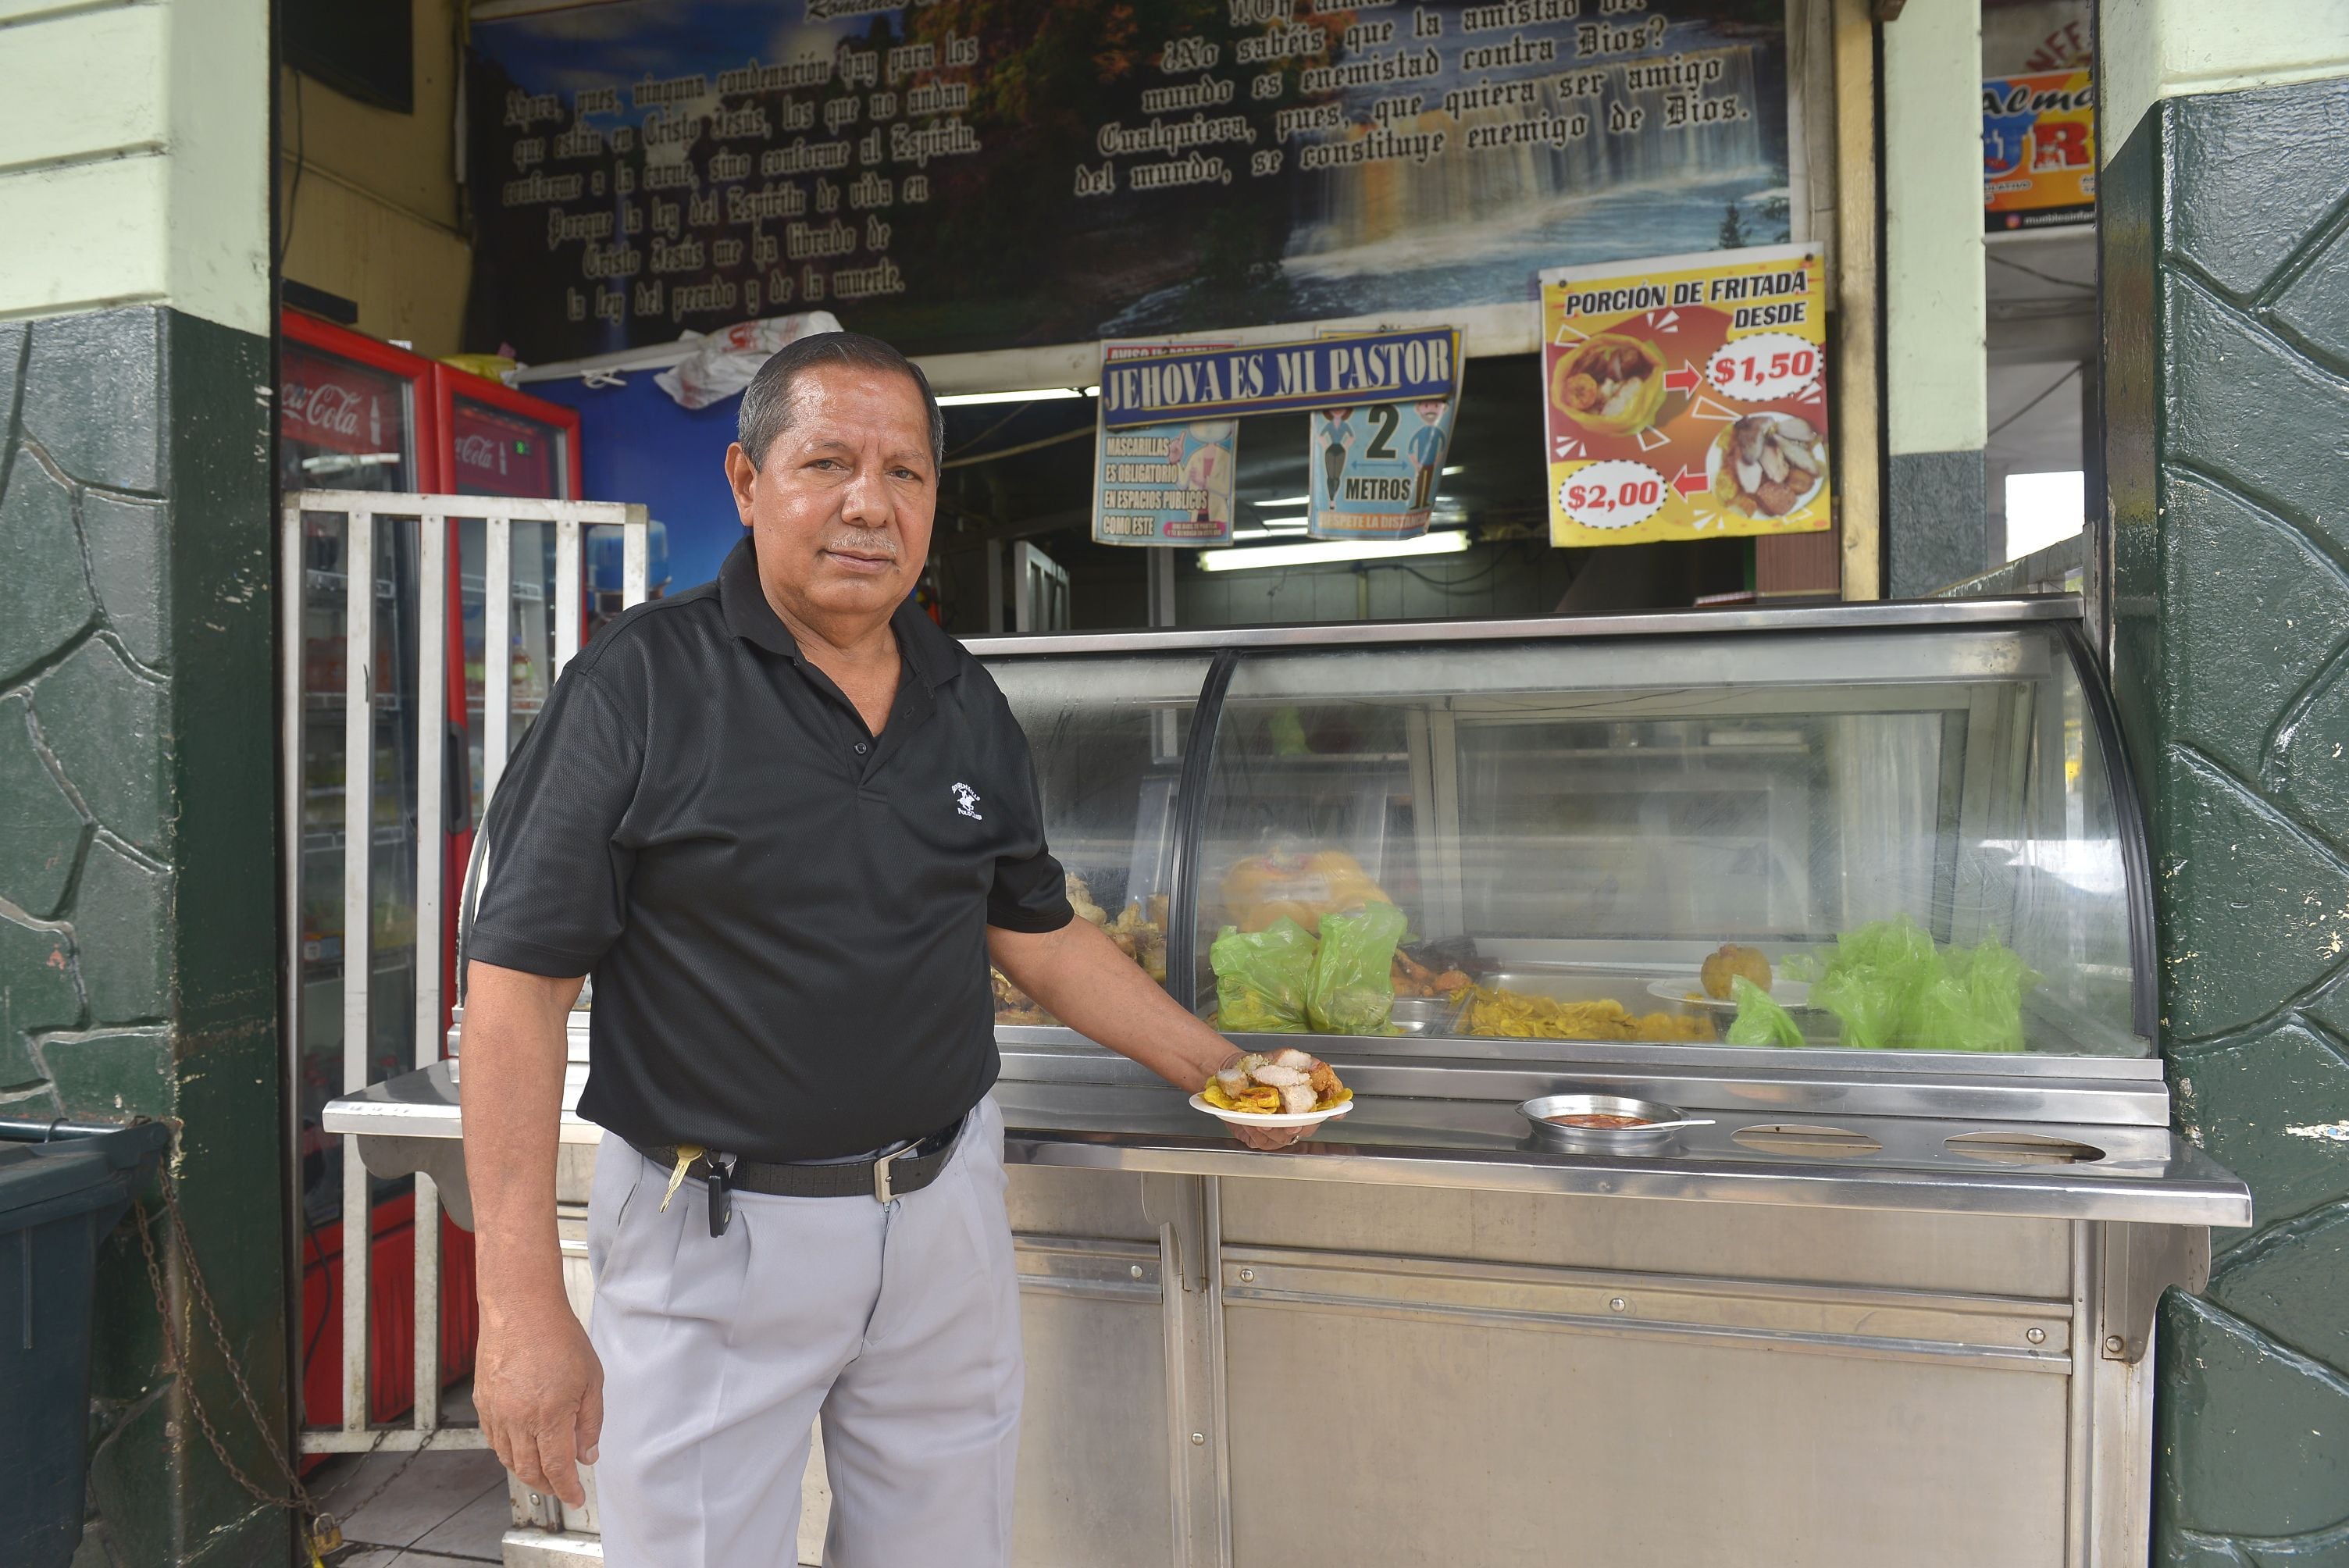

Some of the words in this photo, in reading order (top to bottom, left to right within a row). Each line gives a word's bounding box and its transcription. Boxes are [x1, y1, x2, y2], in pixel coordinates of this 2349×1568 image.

[889, 43, 934, 83] para
[945, 30, 979, 66] los
[1142, 76, 1234, 112] mundo
[1252, 73, 1282, 99] es
[1301, 48, 1440, 92] enemistad
[1463, 36, 1554, 71] contra
[1577, 16, 1666, 59] Dios?
[1160, 37, 1219, 73] ¿No
[1238, 25, 1324, 64] sabéis
[1345, 20, 1394, 53] que
[1414, 9, 1440, 37] la
[782, 94, 814, 130] los
[825, 95, 860, 136] que
[869, 91, 897, 119] no
[908, 77, 968, 115] andan
[1099, 112, 1256, 156] Cualquiera,
[1277, 102, 1351, 144] pues,
[1374, 92, 1422, 125] que
[1444, 80, 1535, 123] quiera
[1559, 69, 1605, 98] ser
[1628, 55, 1722, 97] amigo
[615, 159, 635, 194] la
[709, 147, 751, 183] sino
[761, 137, 850, 176] conforme
[860, 127, 882, 165] al
[1075, 162, 1114, 195] del
[1132, 151, 1232, 190] mundo,
[1252, 149, 1283, 176] se
[1301, 124, 1445, 169] constituye
[1467, 111, 1588, 148] enemigo
[1609, 103, 1644, 134] de
[1665, 91, 1749, 128] Dios.
[622, 200, 643, 234] la
[652, 195, 679, 239] ley
[689, 189, 719, 226] del
[817, 176, 840, 212] de
[850, 170, 893, 210] vida
[904, 175, 929, 203] en
[713, 239, 743, 267] me
[786, 219, 857, 260] librado
[867, 215, 891, 252] de
[567, 286, 586, 321] la
[595, 283, 626, 325] ley
[635, 280, 663, 316] del
[746, 279, 760, 315] y
[769, 268, 793, 304] de
[803, 265, 825, 301] la
[1566, 283, 1666, 315] PORCIÓN
[1674, 282, 1703, 305] DE
[1710, 270, 1807, 301] FRITADA
[1734, 301, 1805, 330] DESDE
[1105, 361, 1223, 412] JEHOVA
[1228, 354, 1264, 400] ES
[1276, 348, 1317, 395] MI
[1328, 338, 1449, 390] PASTOR
[1713, 350, 1815, 386] $1,50
[1106, 437, 1170, 457] MASCARILLAS
[1367, 404, 1399, 459] 2
[1103, 492, 1117, 509] EN
[1117, 491, 1162, 510] ESPACIOS
[1163, 490, 1208, 510] PUBLICOS
[1105, 465, 1117, 483] ES
[1118, 464, 1178, 483] OBLIGATORIO
[1346, 479, 1411, 501] METROS
[1567, 480, 1659, 511] $2,00
[1103, 516, 1132, 534] COMO
[1132, 517, 1153, 534] ESTE
